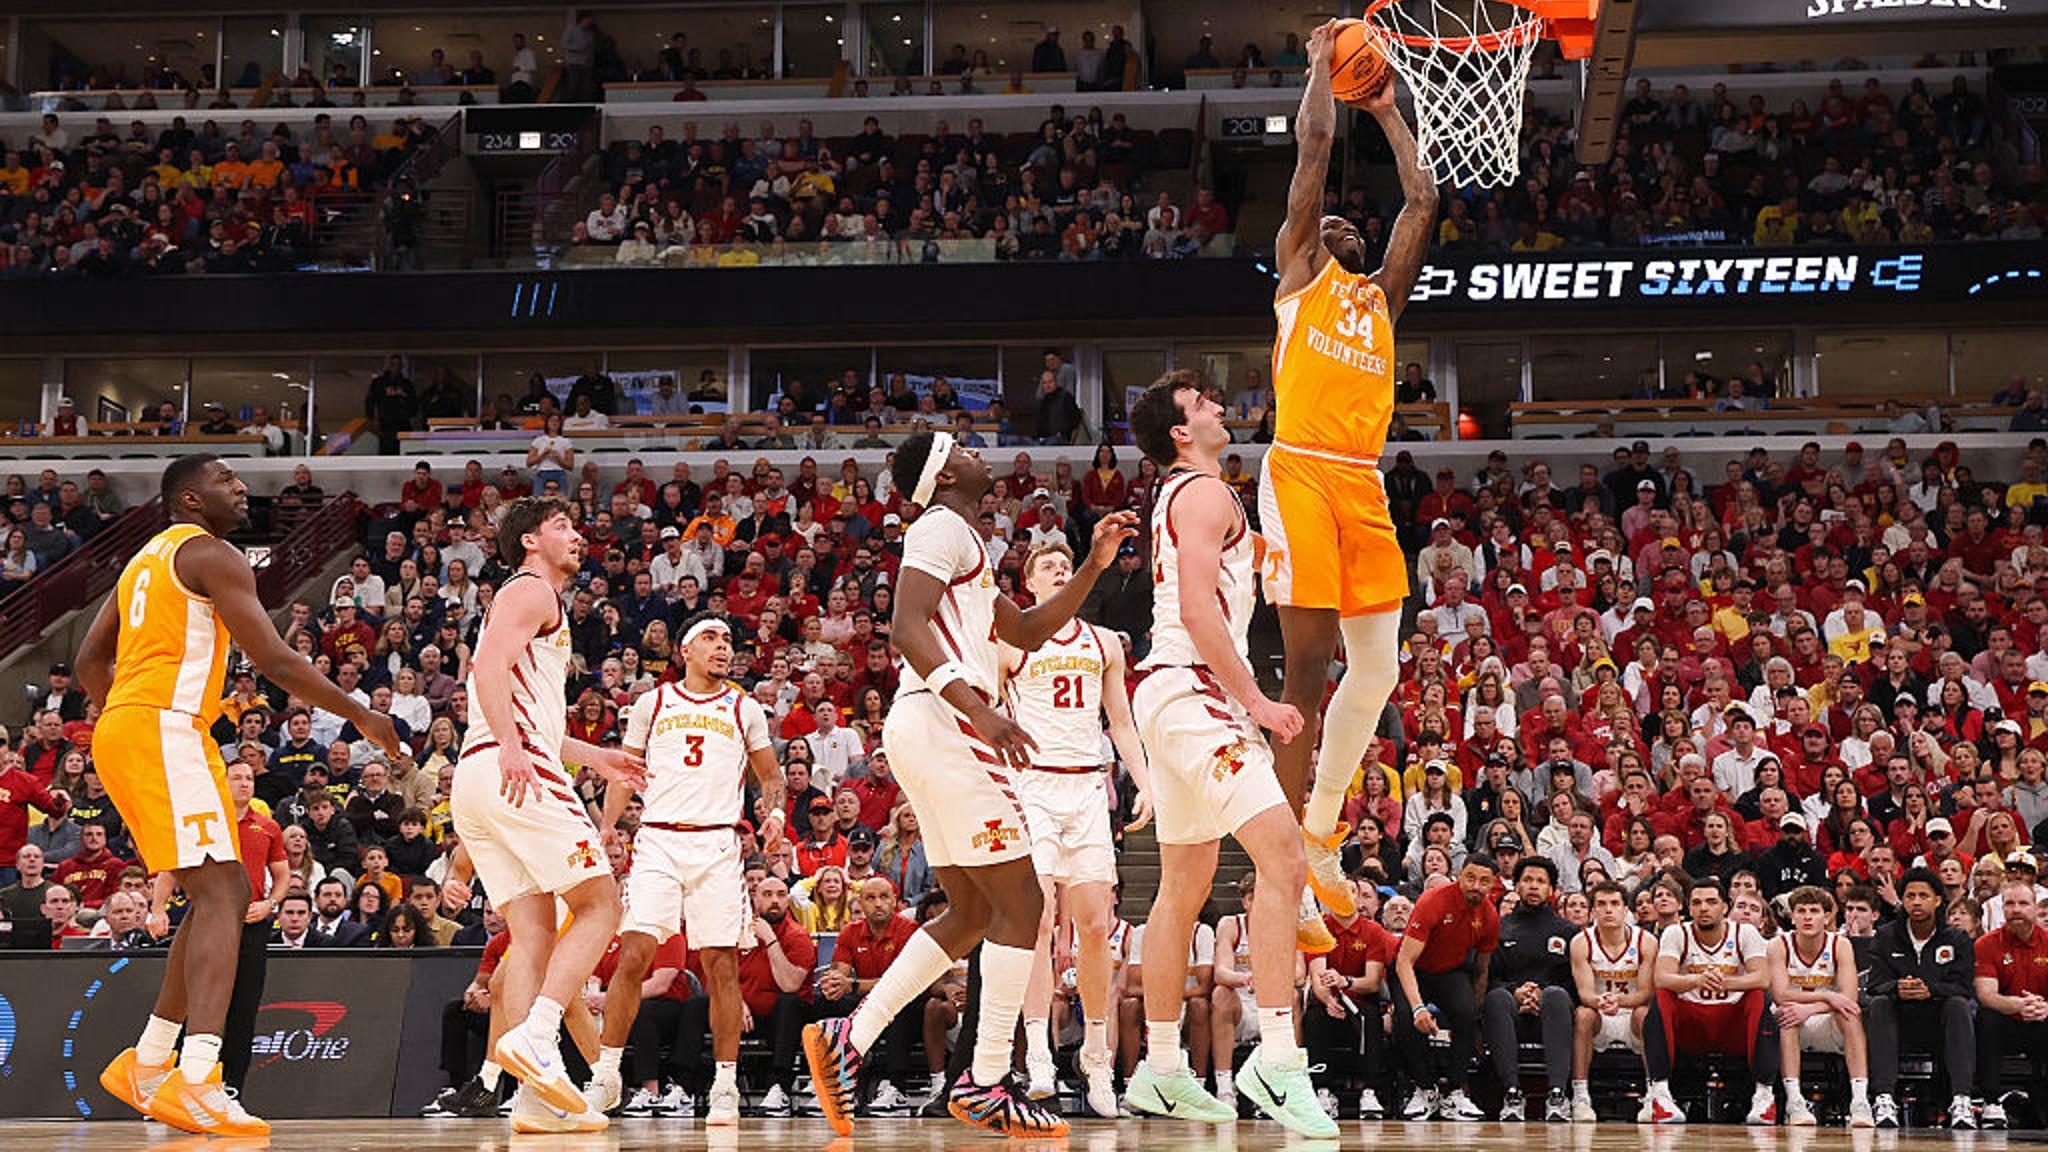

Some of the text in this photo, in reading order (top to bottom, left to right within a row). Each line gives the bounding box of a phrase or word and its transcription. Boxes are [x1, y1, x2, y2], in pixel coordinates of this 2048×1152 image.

[1467, 256, 1859, 300] SWEET SIXTEEN
[1336, 299, 1374, 349] 34
[129, 567, 151, 629] 6
[1053, 675, 1085, 708] 21
[684, 735, 704, 767] 3
[182, 811, 218, 847] T
